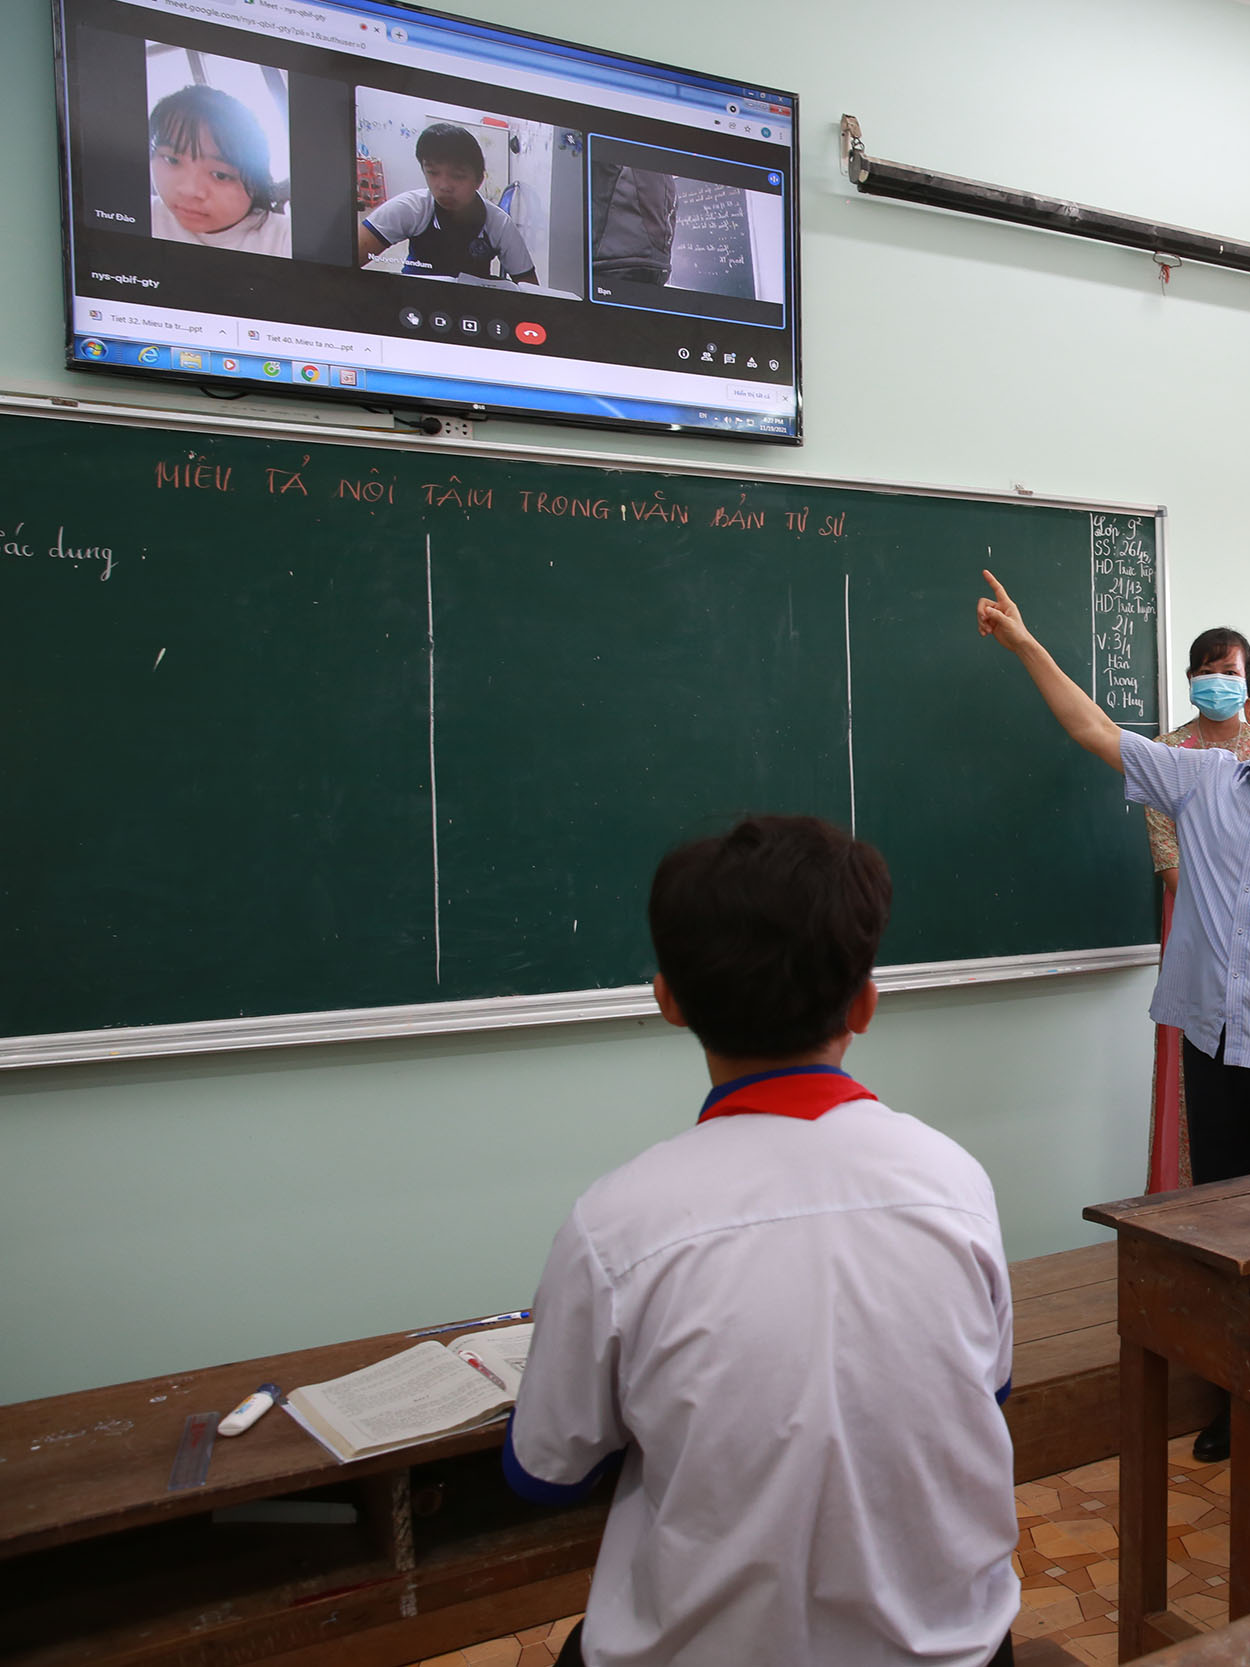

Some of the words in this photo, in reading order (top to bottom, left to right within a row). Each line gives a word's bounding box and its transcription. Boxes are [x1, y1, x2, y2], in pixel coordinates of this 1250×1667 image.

[94, 209, 115, 220] Thư
[91, 271, 161, 289] nys-qbif-gty
[267, 334, 281, 343] Tiet
[295, 338, 314, 347] Mieu
[154, 455, 231, 492] MIÊU
[266, 454, 310, 497] TẢ
[339, 467, 398, 515] NỘI
[421, 475, 493, 510] TÂM
[518, 490, 610, 521] TRONG
[631, 490, 690, 525] VĂN
[709, 493, 765, 530] BẢN
[0, 522, 34, 557] ác
[48, 525, 119, 581] dụng
